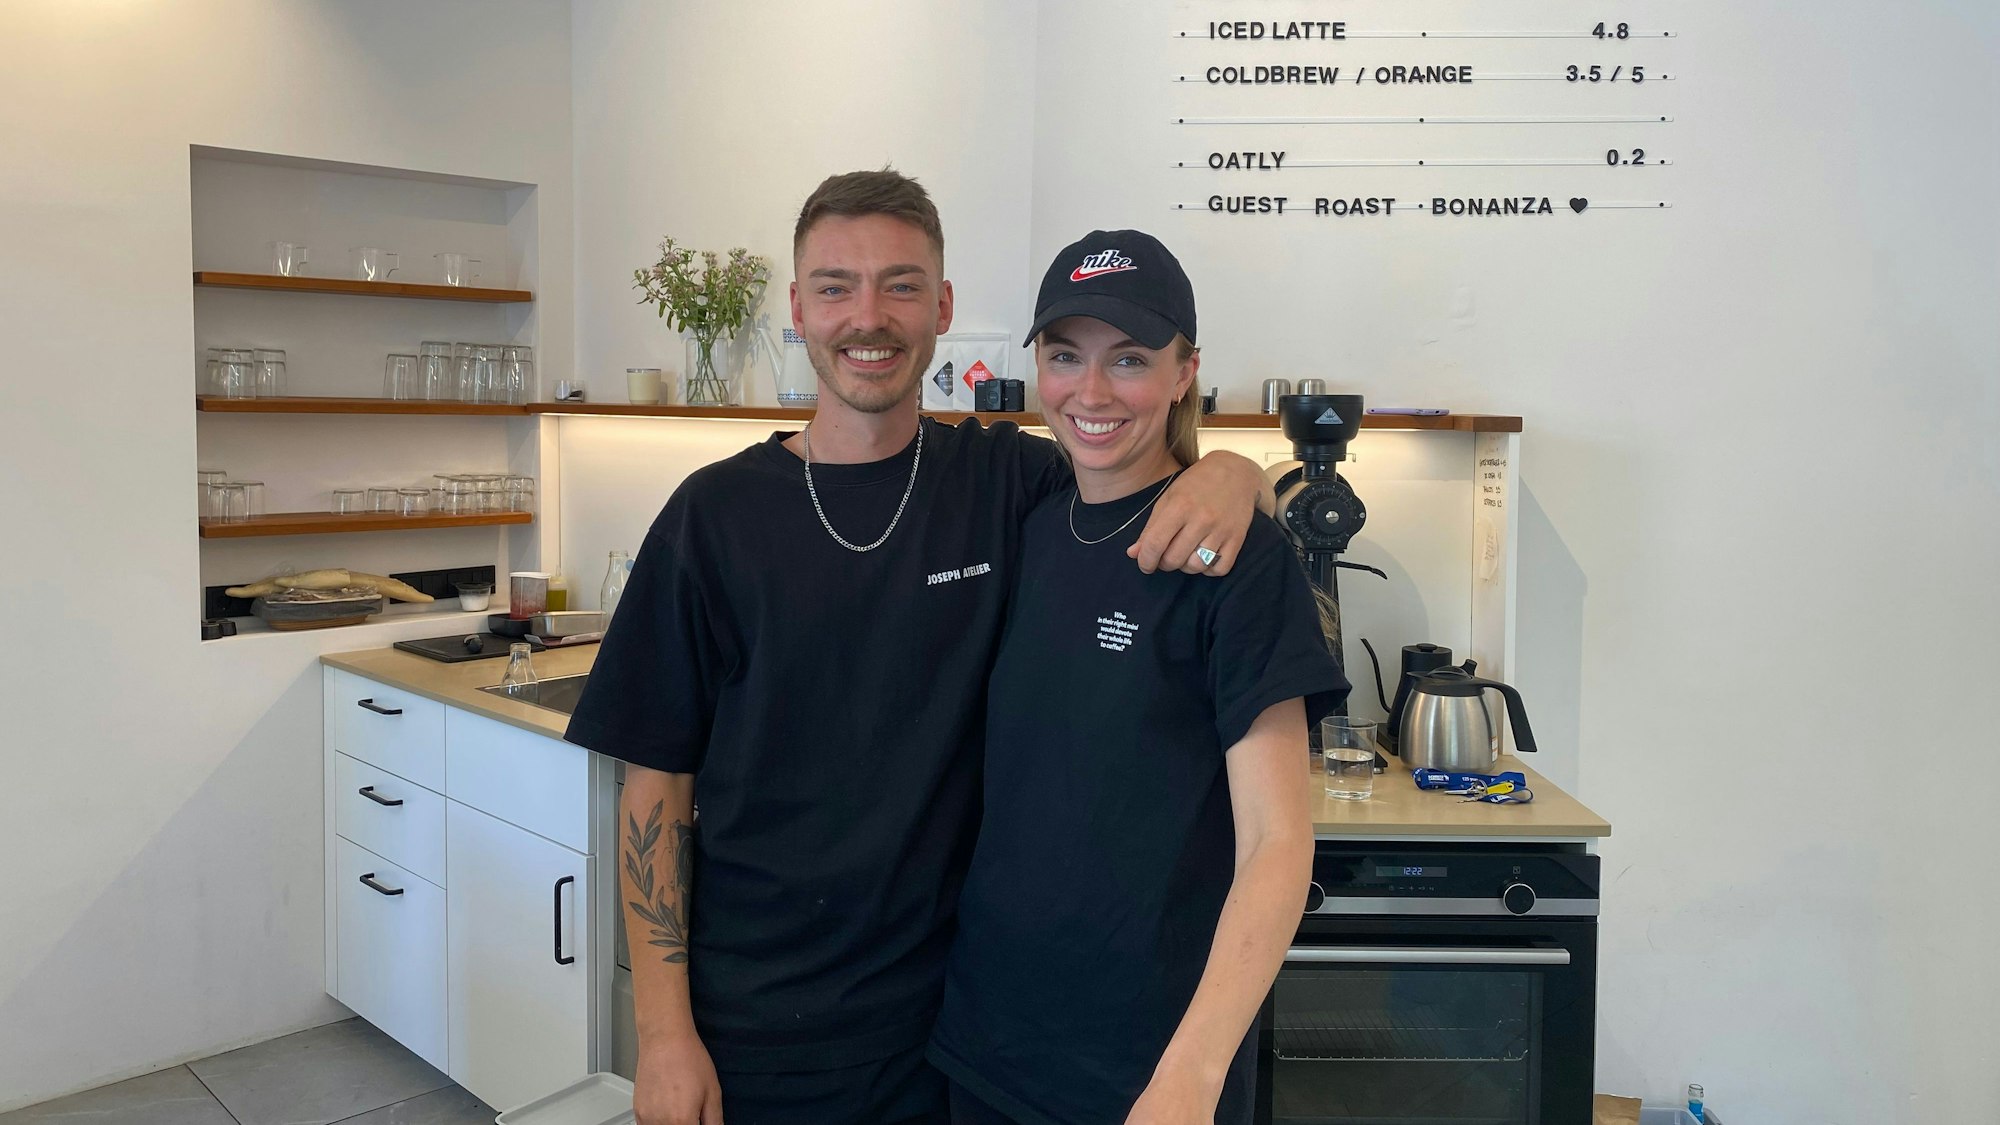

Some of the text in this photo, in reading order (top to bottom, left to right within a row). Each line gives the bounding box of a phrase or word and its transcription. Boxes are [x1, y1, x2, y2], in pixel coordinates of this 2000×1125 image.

[1210, 21, 1346, 40] ICED LATTE
[1592, 22, 1629, 40] 4.8
[1206, 66, 1472, 84] COLDBREW / ORANGE
[1566, 65, 1601, 83] 3.5
[1631, 66, 1644, 84] 5
[1208, 152, 1285, 170] OATLY
[1606, 148, 1645, 166] 0.2
[1208, 195, 1553, 216] GUEST ROAST BONANZA
[927, 562, 992, 586] JOSEPH ATELIER
